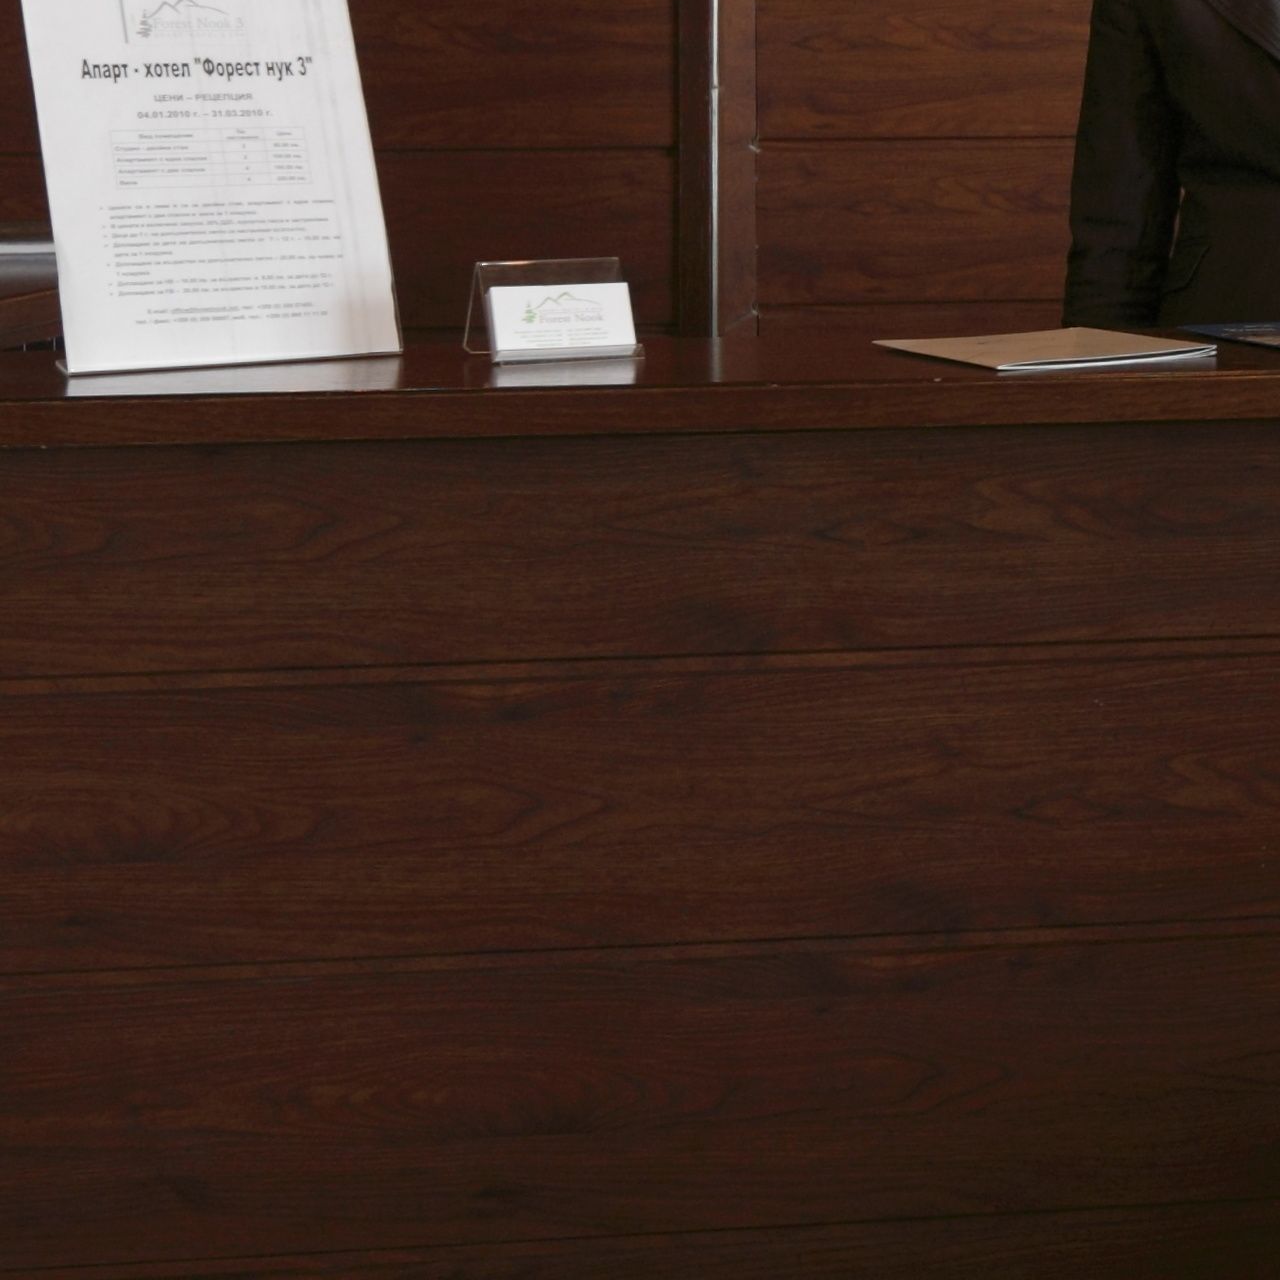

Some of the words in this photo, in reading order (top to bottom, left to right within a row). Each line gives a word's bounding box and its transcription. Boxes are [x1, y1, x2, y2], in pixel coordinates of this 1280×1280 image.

[81, 58, 129, 83] Апарт
[143, 61, 192, 78] хотел
[194, 57, 261, 82] "Форест
[265, 60, 294, 81] нук
[295, 56, 313, 77] 3"
